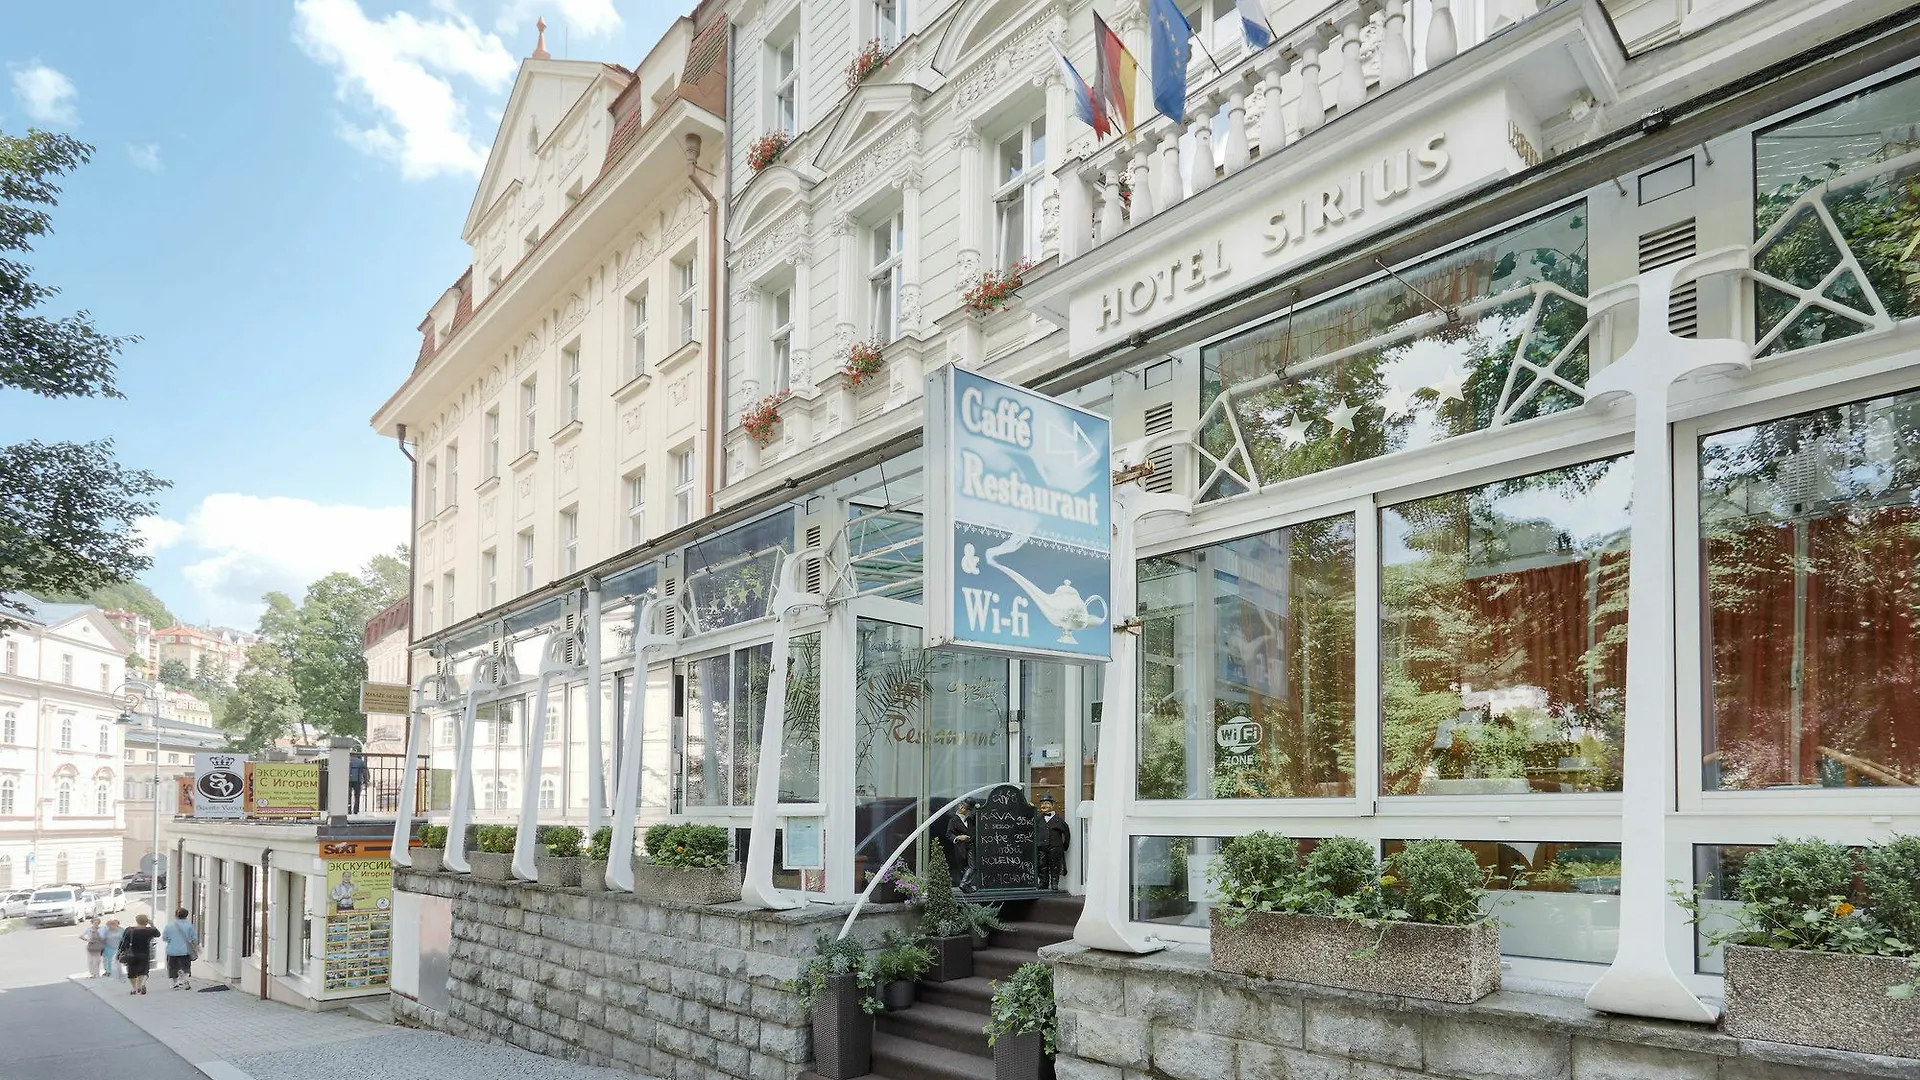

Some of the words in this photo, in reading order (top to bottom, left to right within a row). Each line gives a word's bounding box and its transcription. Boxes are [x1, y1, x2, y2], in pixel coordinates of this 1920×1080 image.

[1096, 239, 1231, 332] HOTEL
[1262, 132, 1451, 256] SIRIUS
[961, 386, 1032, 448] Caffé
[962, 451, 1099, 526] Restaurant
[961, 543, 980, 575] &
[961, 587, 1030, 638] Wi-fi
[257, 768, 318, 778] ЭКСКУРСИИ
[1225, 755, 1254, 766] ZONE
[273, 778, 318, 789] Игорем
[329, 862, 391, 872] ЭКСКУРСИИ
